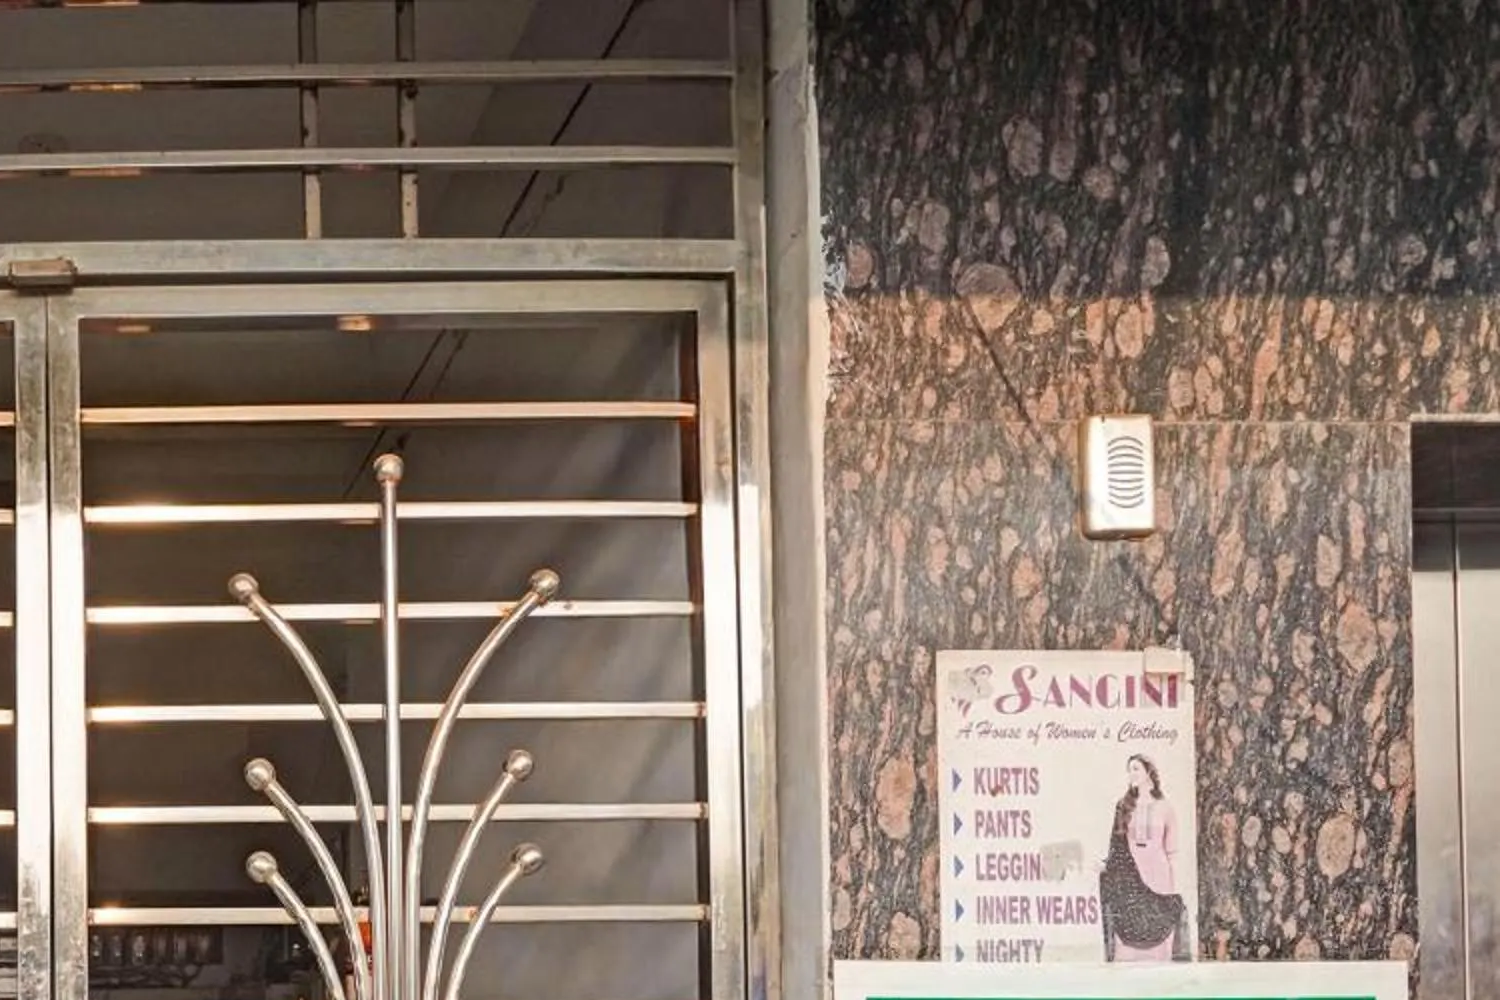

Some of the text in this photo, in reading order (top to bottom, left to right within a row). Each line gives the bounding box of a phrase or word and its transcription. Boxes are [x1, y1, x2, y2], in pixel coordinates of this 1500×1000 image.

[956, 719, 1179, 746] A House of Women's Clothing
[973, 767, 1040, 796] KURTIS
[974, 810, 1032, 839] PANTS
[976, 895, 1098, 924] INNER WEARS
[976, 938, 1045, 962] NIGHTY
